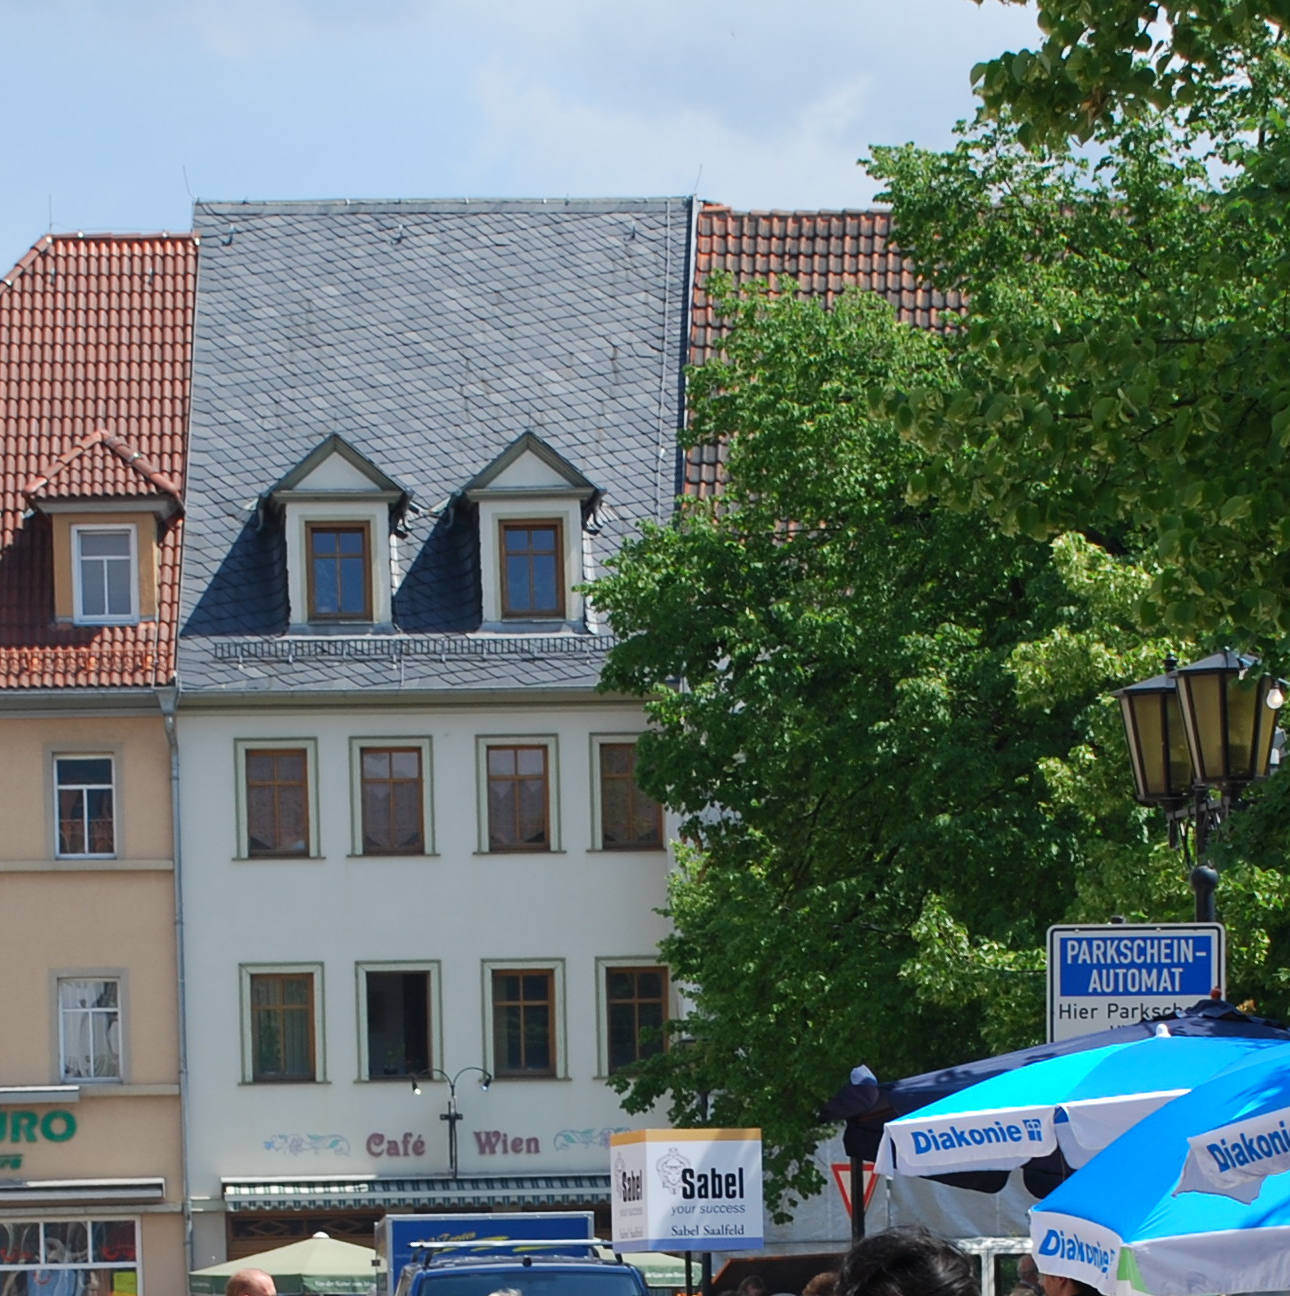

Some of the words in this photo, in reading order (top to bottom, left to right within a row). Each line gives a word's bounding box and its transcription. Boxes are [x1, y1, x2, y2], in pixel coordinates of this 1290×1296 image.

[1066, 938, 1207, 965] PARKSCHEIN-
[1088, 968, 1183, 993] AUTOMAT
[1059, 1003, 1098, 1020] Hier
[366, 1132, 425, 1157] Café
[473, 1130, 540, 1155] Wien
[911, 1121, 1023, 1155] Diakonie
[681, 1167, 744, 1200] Sabel
[671, 1204, 696, 1217] your
[700, 1204, 746, 1215] success
[671, 1225, 699, 1237] Sabel
[703, 1224, 745, 1236] Saalfeld
[1038, 1229, 1110, 1274] Diakonie
